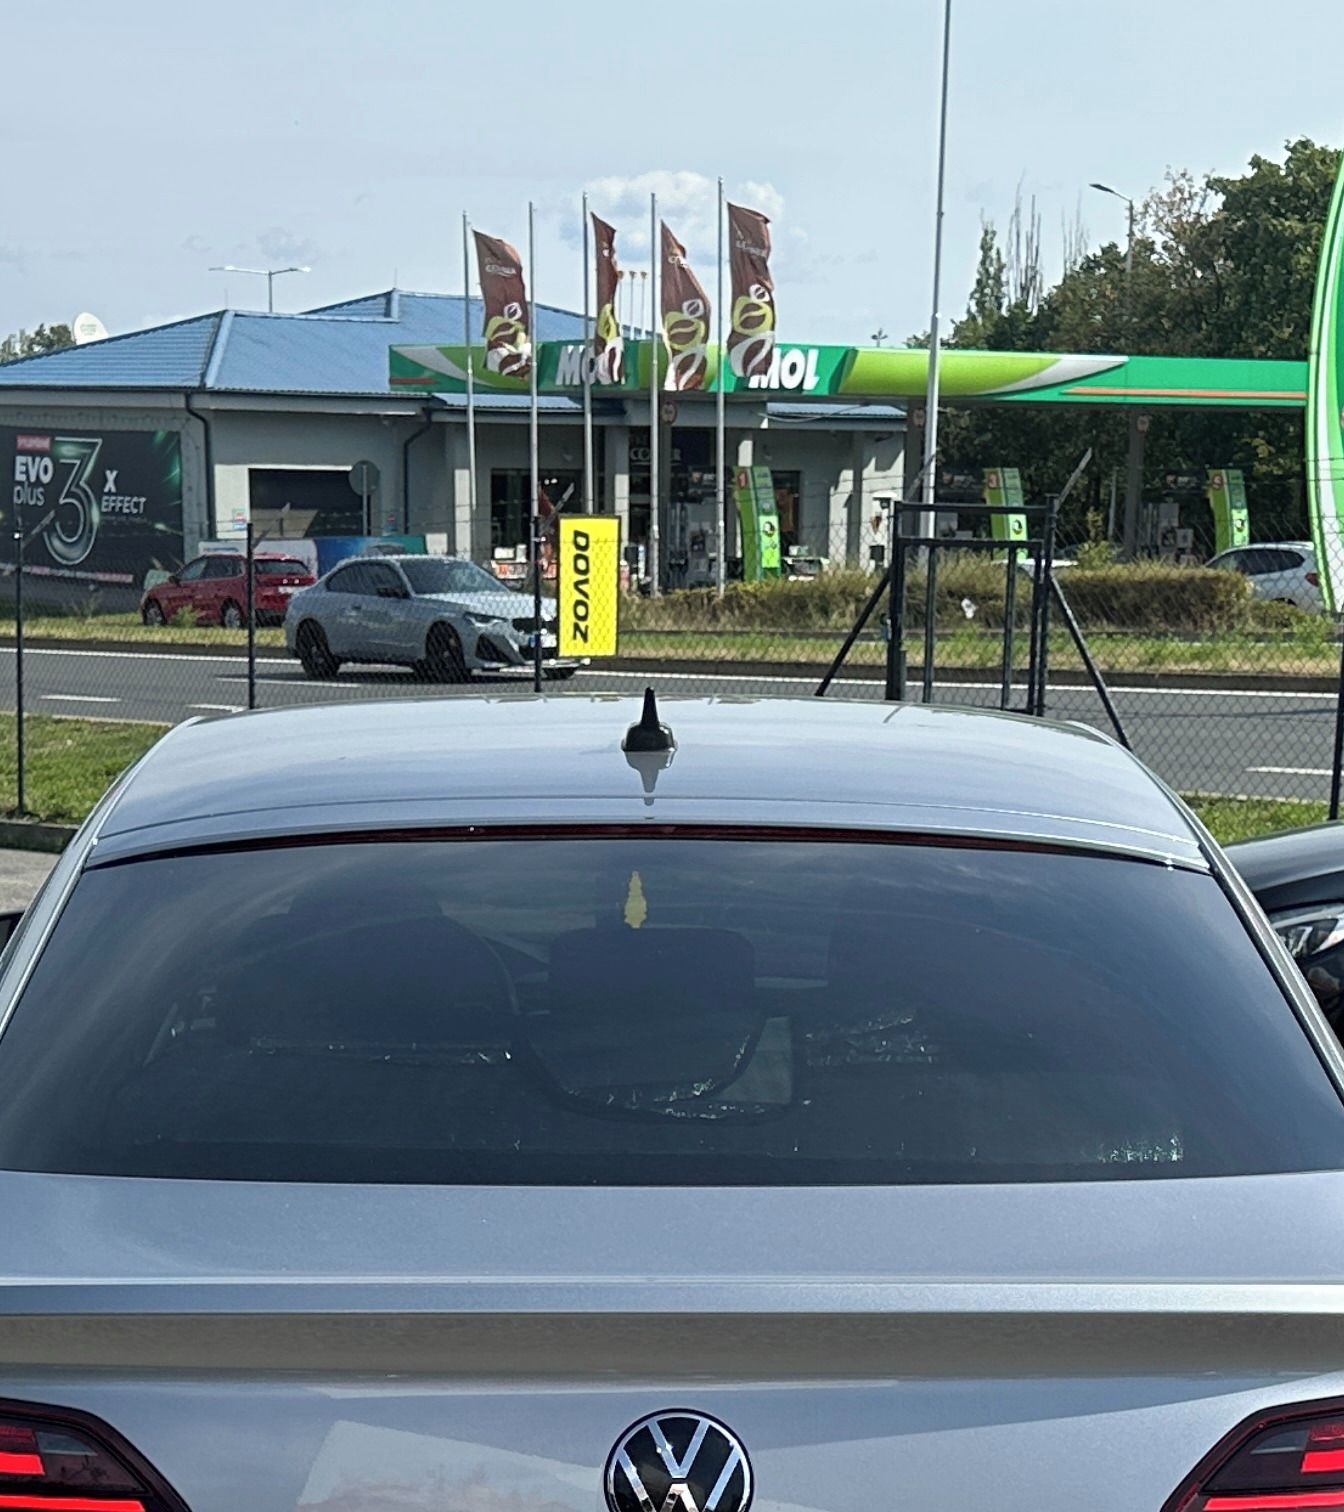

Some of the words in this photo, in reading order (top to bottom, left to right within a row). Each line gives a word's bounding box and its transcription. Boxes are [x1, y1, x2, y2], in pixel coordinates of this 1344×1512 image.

[14, 455, 53, 484] EVO
[103, 470, 119, 493] X
[43, 436, 103, 565] 3
[101, 495, 147, 514] EFFECT
[572, 529, 590, 644] DOVOZ
